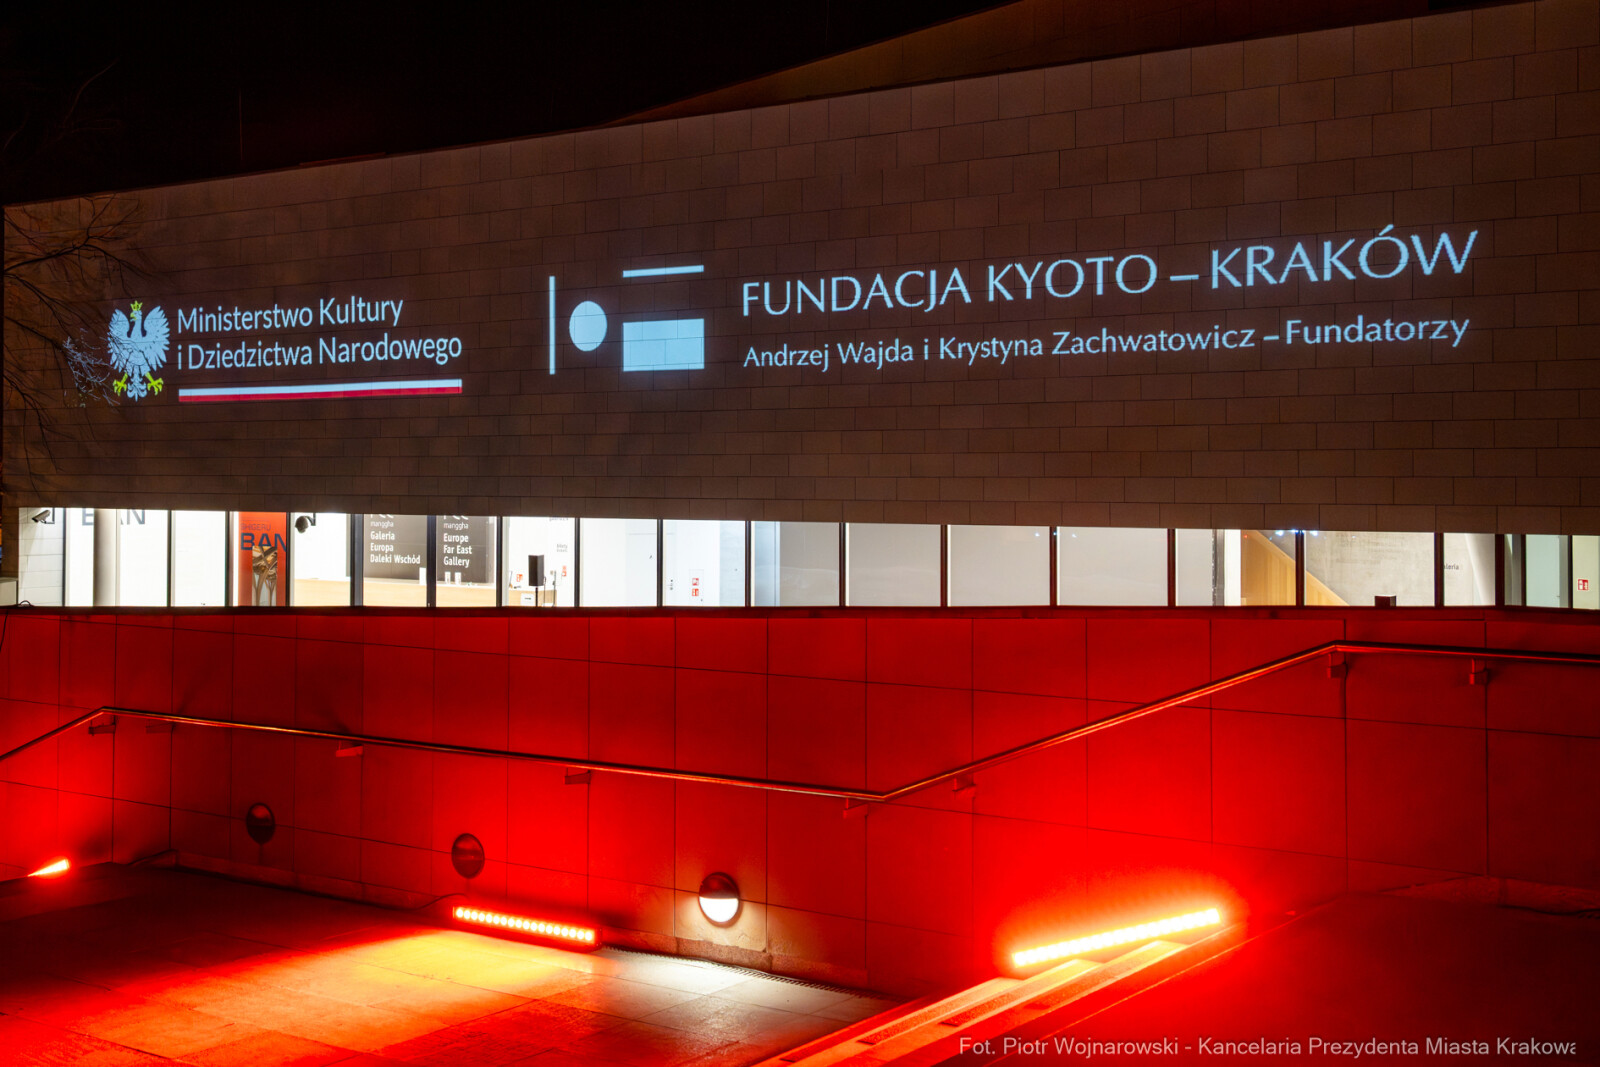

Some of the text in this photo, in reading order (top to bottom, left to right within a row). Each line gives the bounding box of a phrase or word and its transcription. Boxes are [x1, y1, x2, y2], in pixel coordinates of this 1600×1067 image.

[742, 266, 972, 317] FUNDACJA
[987, 253, 1158, 303] KYOTO
[1211, 223, 1479, 290] KRAKÓW
[177, 295, 404, 334] Ministerstwo Kultury
[743, 343, 829, 373] Andrzej
[836, 337, 915, 371] Wajda
[923, 337, 929, 361] i
[939, 336, 1044, 367] Krystyna
[1051, 324, 1256, 355] Zachwatowicz
[1285, 314, 1470, 348] Fundatorzy
[177, 332, 463, 370] i Dziedzictwa Narodowego
[443, 522, 469, 530] manggha
[370, 531, 396, 540] Galeria
[443, 533, 469, 544] Europe
[370, 543, 394, 553] Europa
[443, 545, 473, 554] Far East
[370, 554, 421, 564] Daleki Wschód
[443, 556, 470, 568] Gallery
